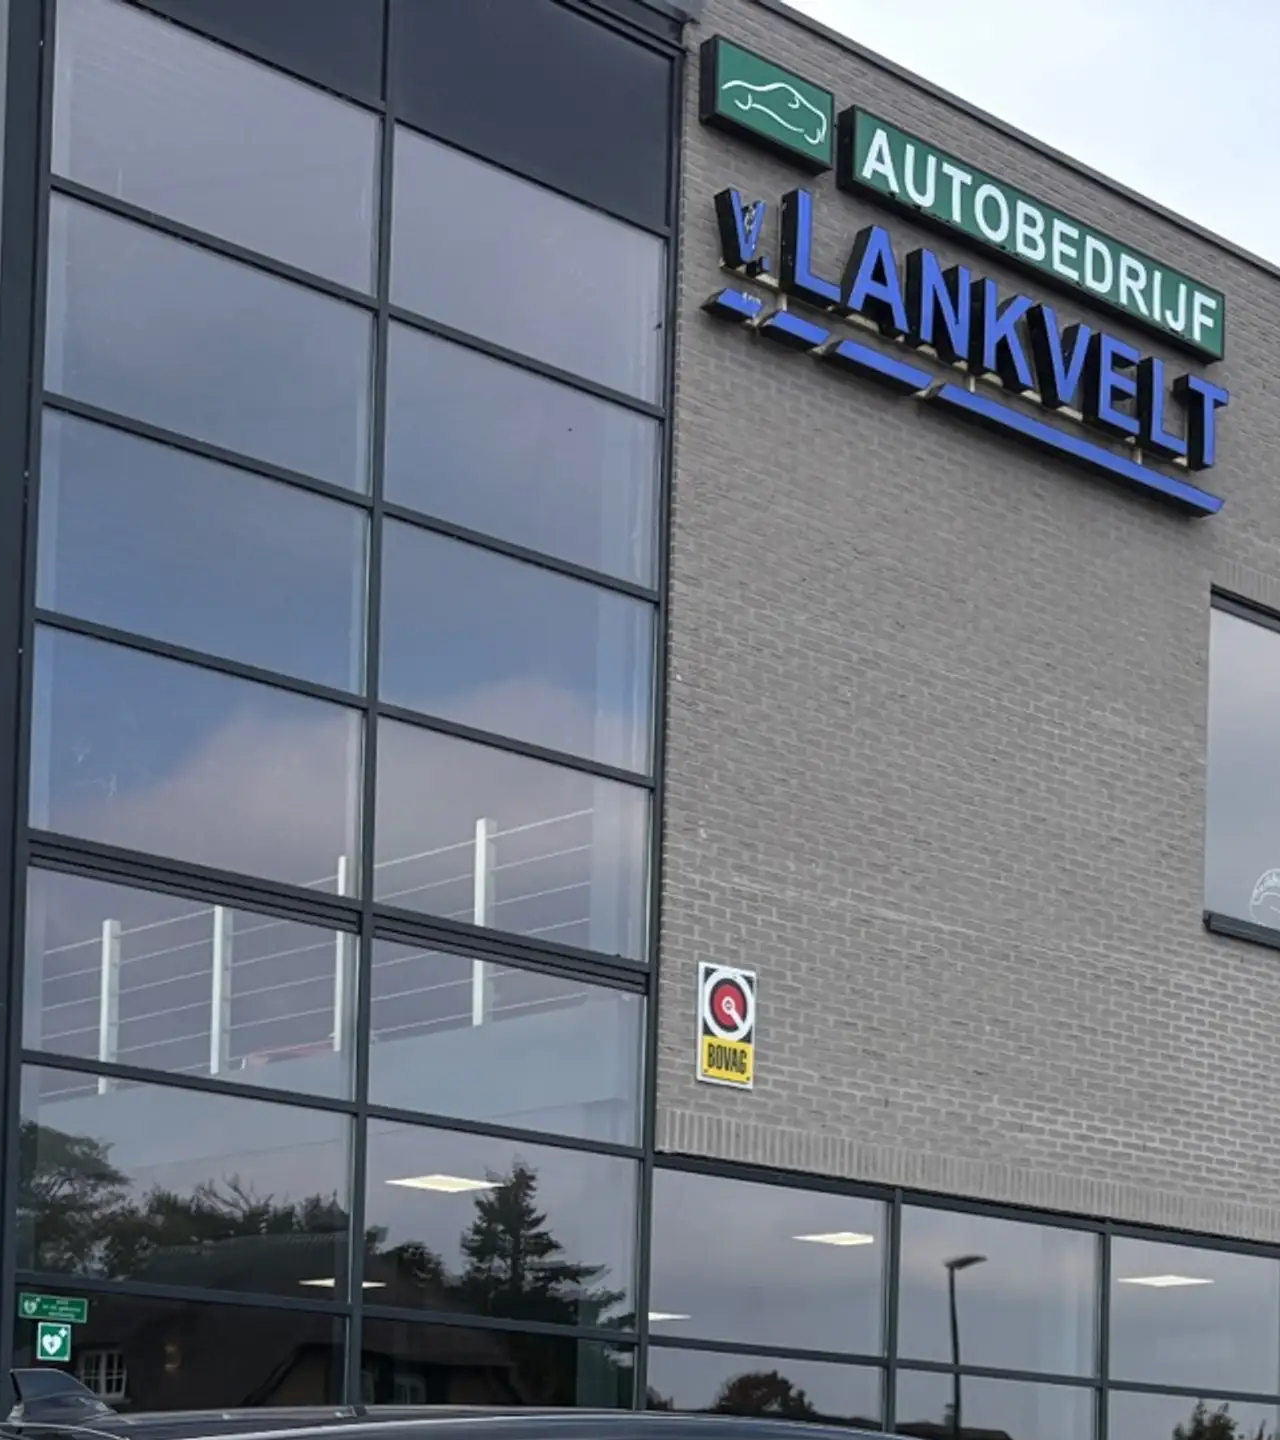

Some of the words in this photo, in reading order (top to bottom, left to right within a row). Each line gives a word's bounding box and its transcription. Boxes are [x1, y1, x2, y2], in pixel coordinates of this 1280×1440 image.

[783, 187, 1229, 470] LANKVELT
[861, 128, 1217, 344] AUTOBEDRIJF
[707, 1043, 748, 1074] BOVAG
